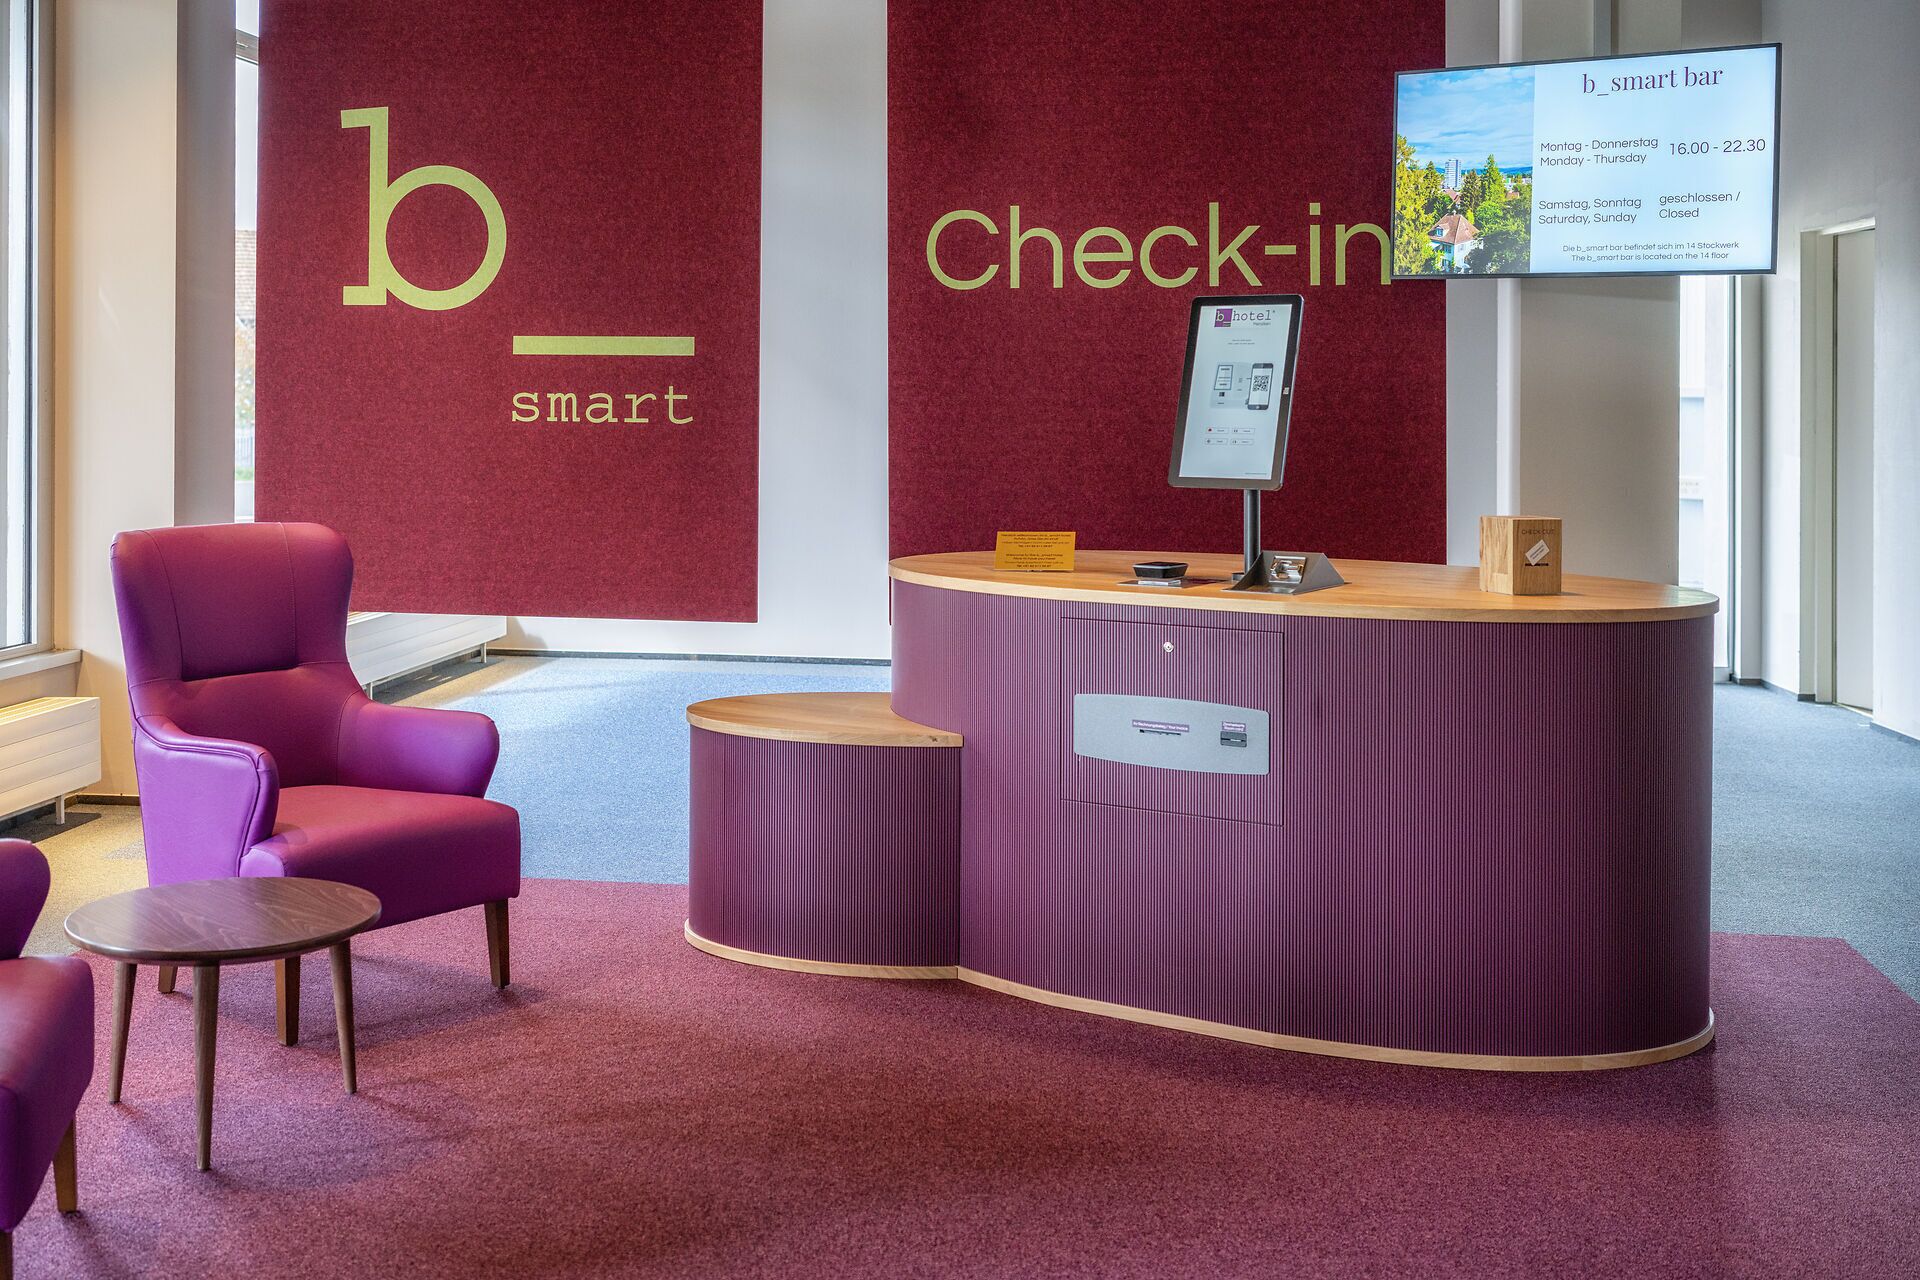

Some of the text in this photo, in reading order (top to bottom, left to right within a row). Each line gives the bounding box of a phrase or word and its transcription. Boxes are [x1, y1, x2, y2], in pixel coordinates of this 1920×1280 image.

[1582, 66, 1724, 96] b_smart bar
[1540, 142, 1582, 153] Montag
[1592, 138, 1659, 150] Donnerstag
[1670, 141, 1710, 155] 16.00
[1723, 139, 1766, 153] 22.30
[1540, 156, 1584, 167] Monday
[1594, 153, 1647, 165] Thursday
[1538, 197, 1642, 211] Samstag, Sonntag
[1659, 191, 1740, 206] geschlossen /
[1538, 211, 1637, 226] Saturday, Sunday
[1659, 207, 1699, 219] Closed
[926, 202, 1391, 290] Check-in
[1563, 244, 1575, 252] Die
[1577, 244, 1608, 253] b_smart
[1610, 243, 1623, 251] bar
[1624, 243, 1656, 251] befindet
[1657, 242, 1673, 250] sich
[1675, 242, 1684, 250] im
[1697, 241, 1739, 249] Stockwerk
[1571, 254, 1585, 262] The
[1587, 253, 1619, 262] b_smart
[1620, 253, 1634, 261] bar
[1642, 252, 1672, 260] located
[1711, 251, 1729, 259] floor
[1232, 309, 1272, 321] hotel
[511, 385, 694, 425] smart
